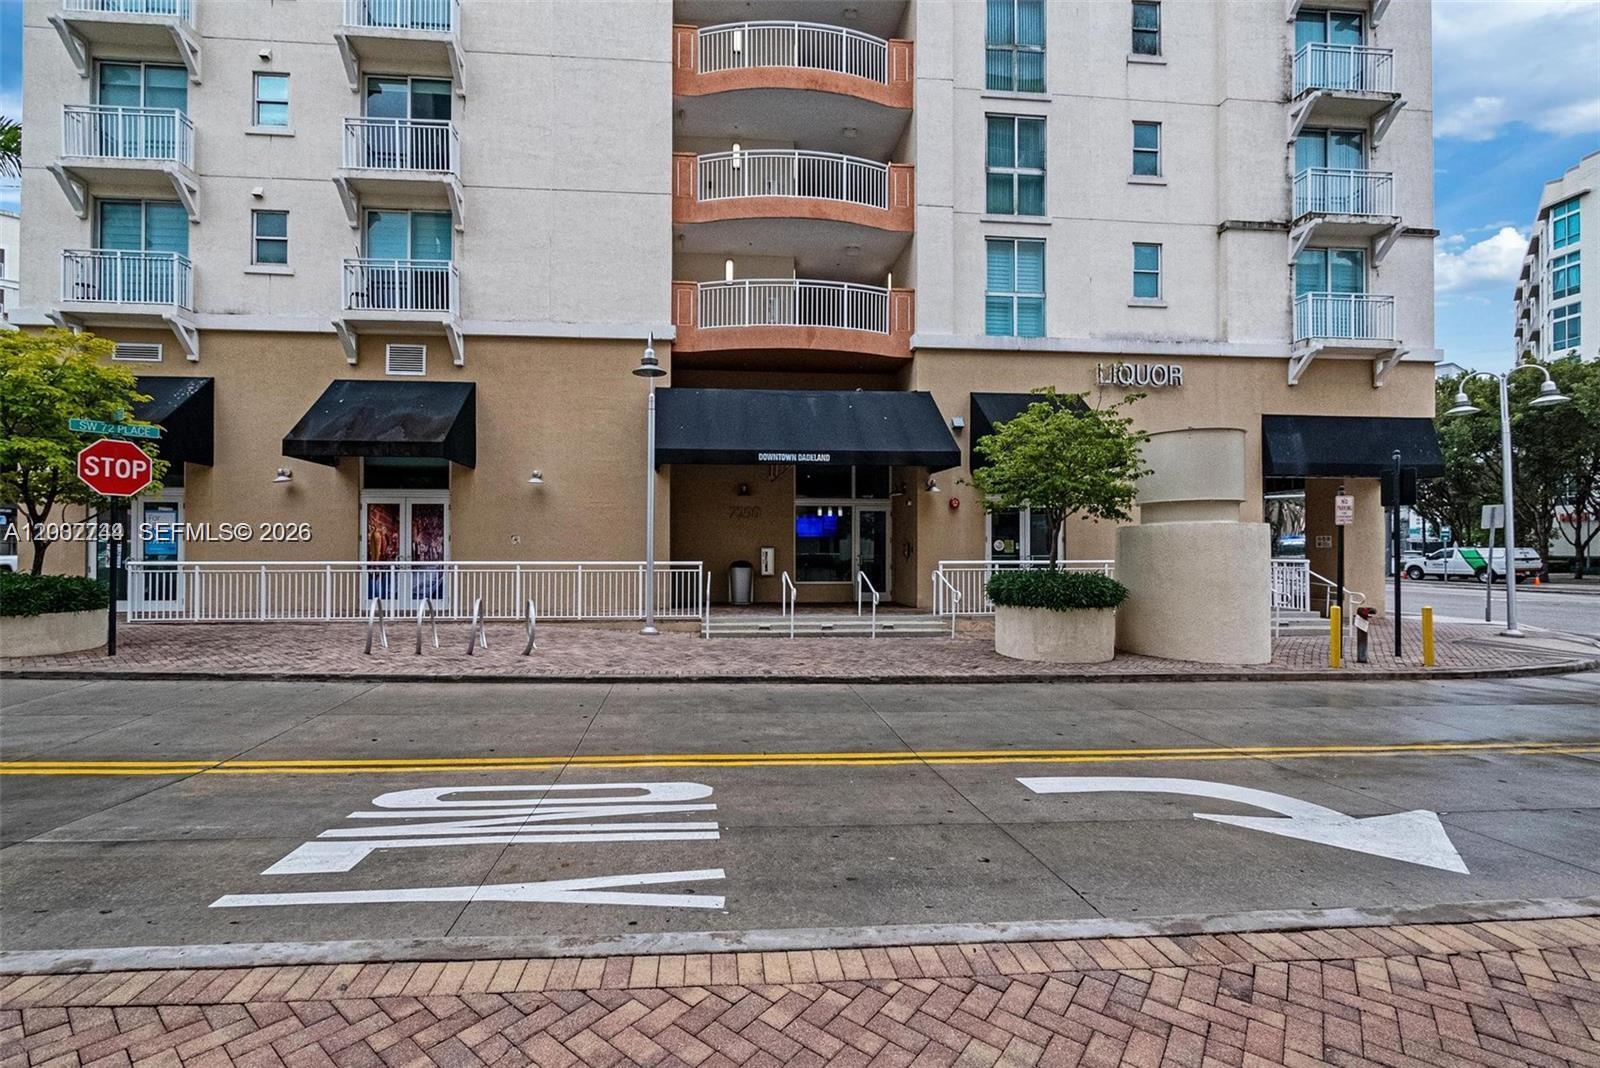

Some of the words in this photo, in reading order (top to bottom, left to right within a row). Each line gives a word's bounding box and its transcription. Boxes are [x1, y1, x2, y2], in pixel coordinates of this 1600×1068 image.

[1097, 362, 1183, 386] LIQUOR
[80, 421, 97, 431] SW
[102, 423, 115, 433] 72
[118, 425, 151, 436] PLACE
[84, 456, 147, 480] STOP
[758, 453, 797, 461] DOWNTOWN
[798, 454, 830, 462] DADELAND
[208, 782, 725, 908] ONLY
